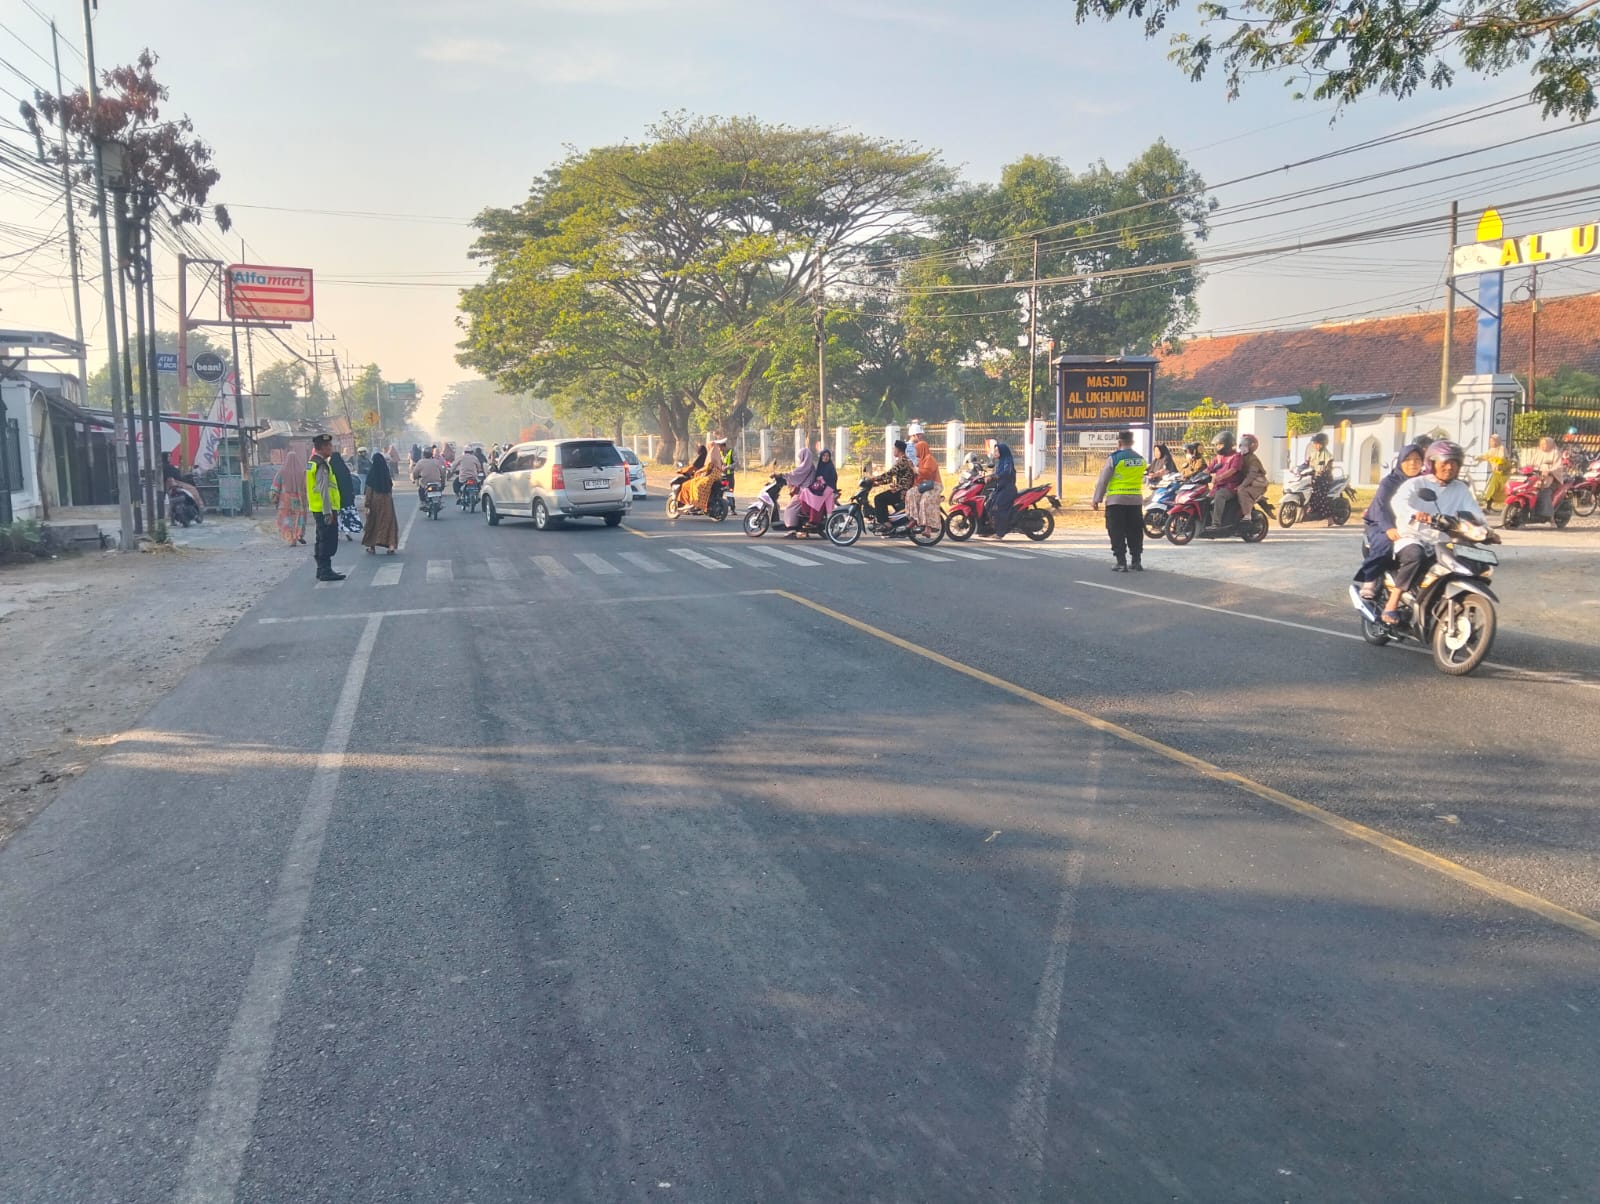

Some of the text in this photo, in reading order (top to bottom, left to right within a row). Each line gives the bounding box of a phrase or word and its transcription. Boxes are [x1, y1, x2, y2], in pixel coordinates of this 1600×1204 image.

[233, 271, 305, 287] Alfamart
[1087, 376, 1127, 387] MASJID
[1069, 391, 1144, 403] AL UKHUWWAH
[1067, 407, 1145, 418] LANUD ISWAHJUDI
